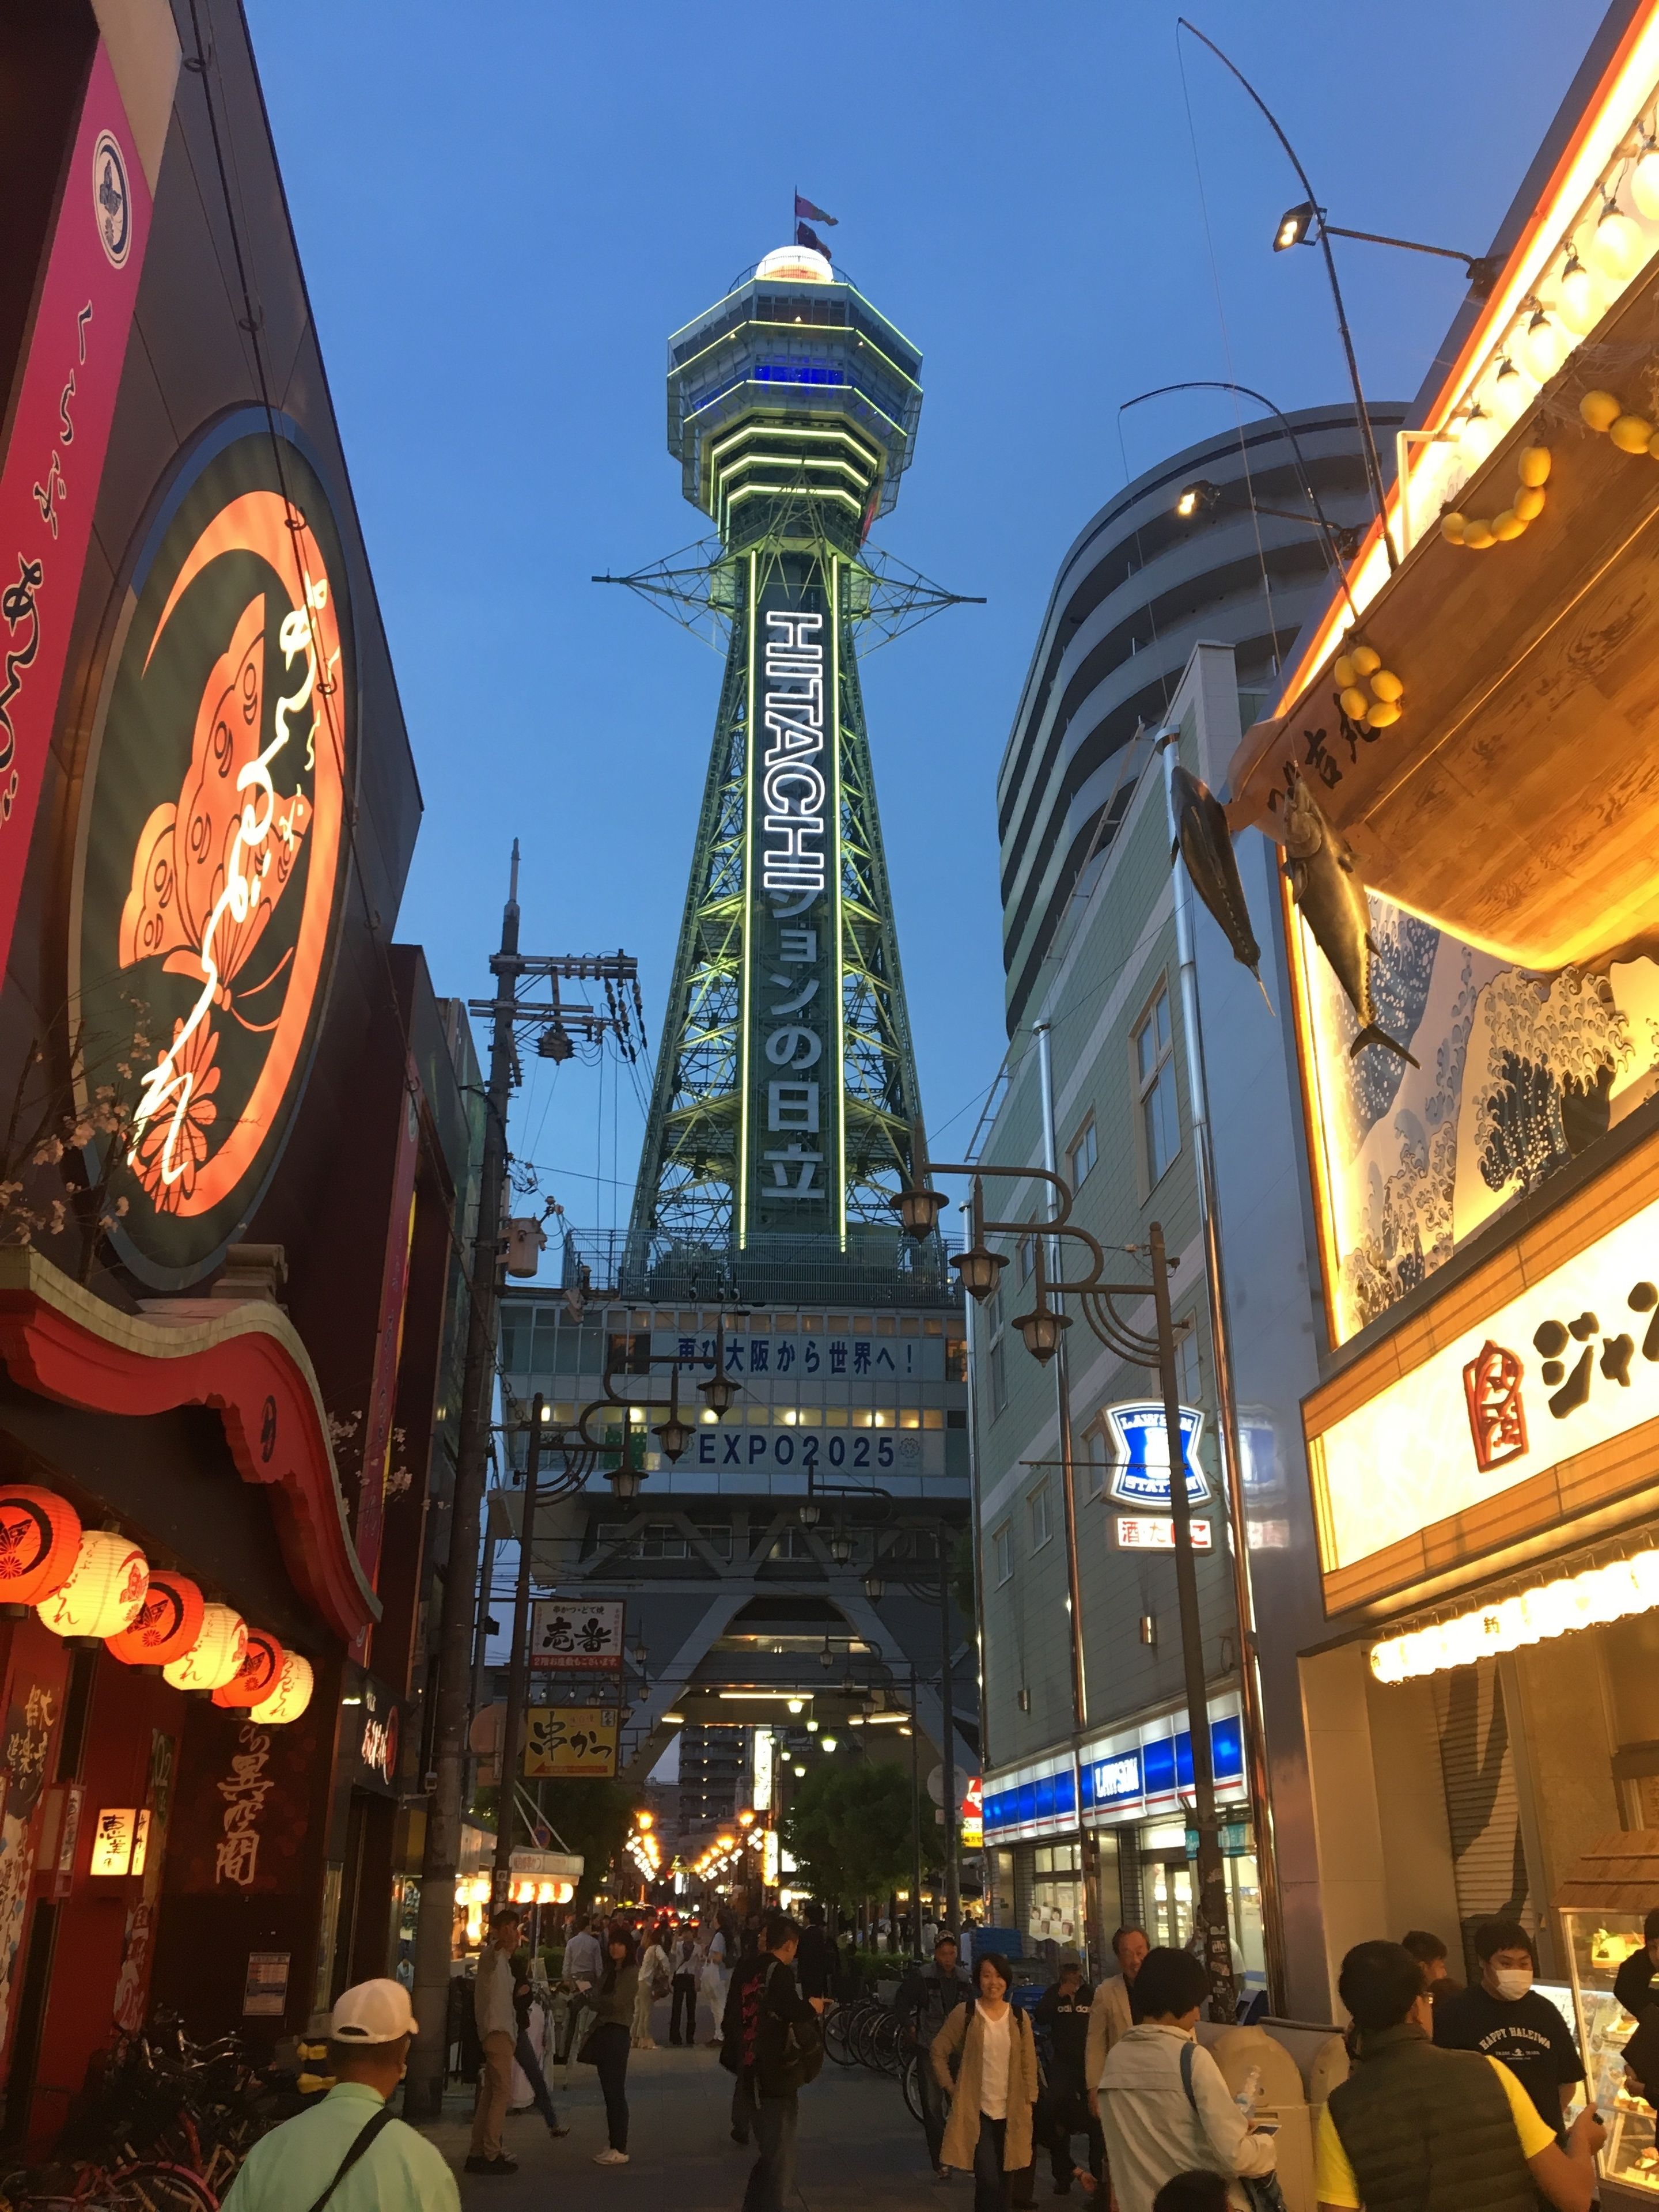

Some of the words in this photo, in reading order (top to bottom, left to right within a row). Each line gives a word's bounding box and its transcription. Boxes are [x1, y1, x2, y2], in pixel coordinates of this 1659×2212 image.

[763, 610, 825, 891] HITACHI
[1120, 1413, 1193, 1432] LAWSN
[699, 1434, 894, 1468] EXPO2025
[1124, 1475, 1199, 1493] STATN
[529, 1710, 613, 1762] 串かつ
[1094, 1756, 1139, 1798] LAWSON
[1479, 2028, 1508, 2050] HAPPY
[1509, 2027, 1551, 2049] HALEIWA
